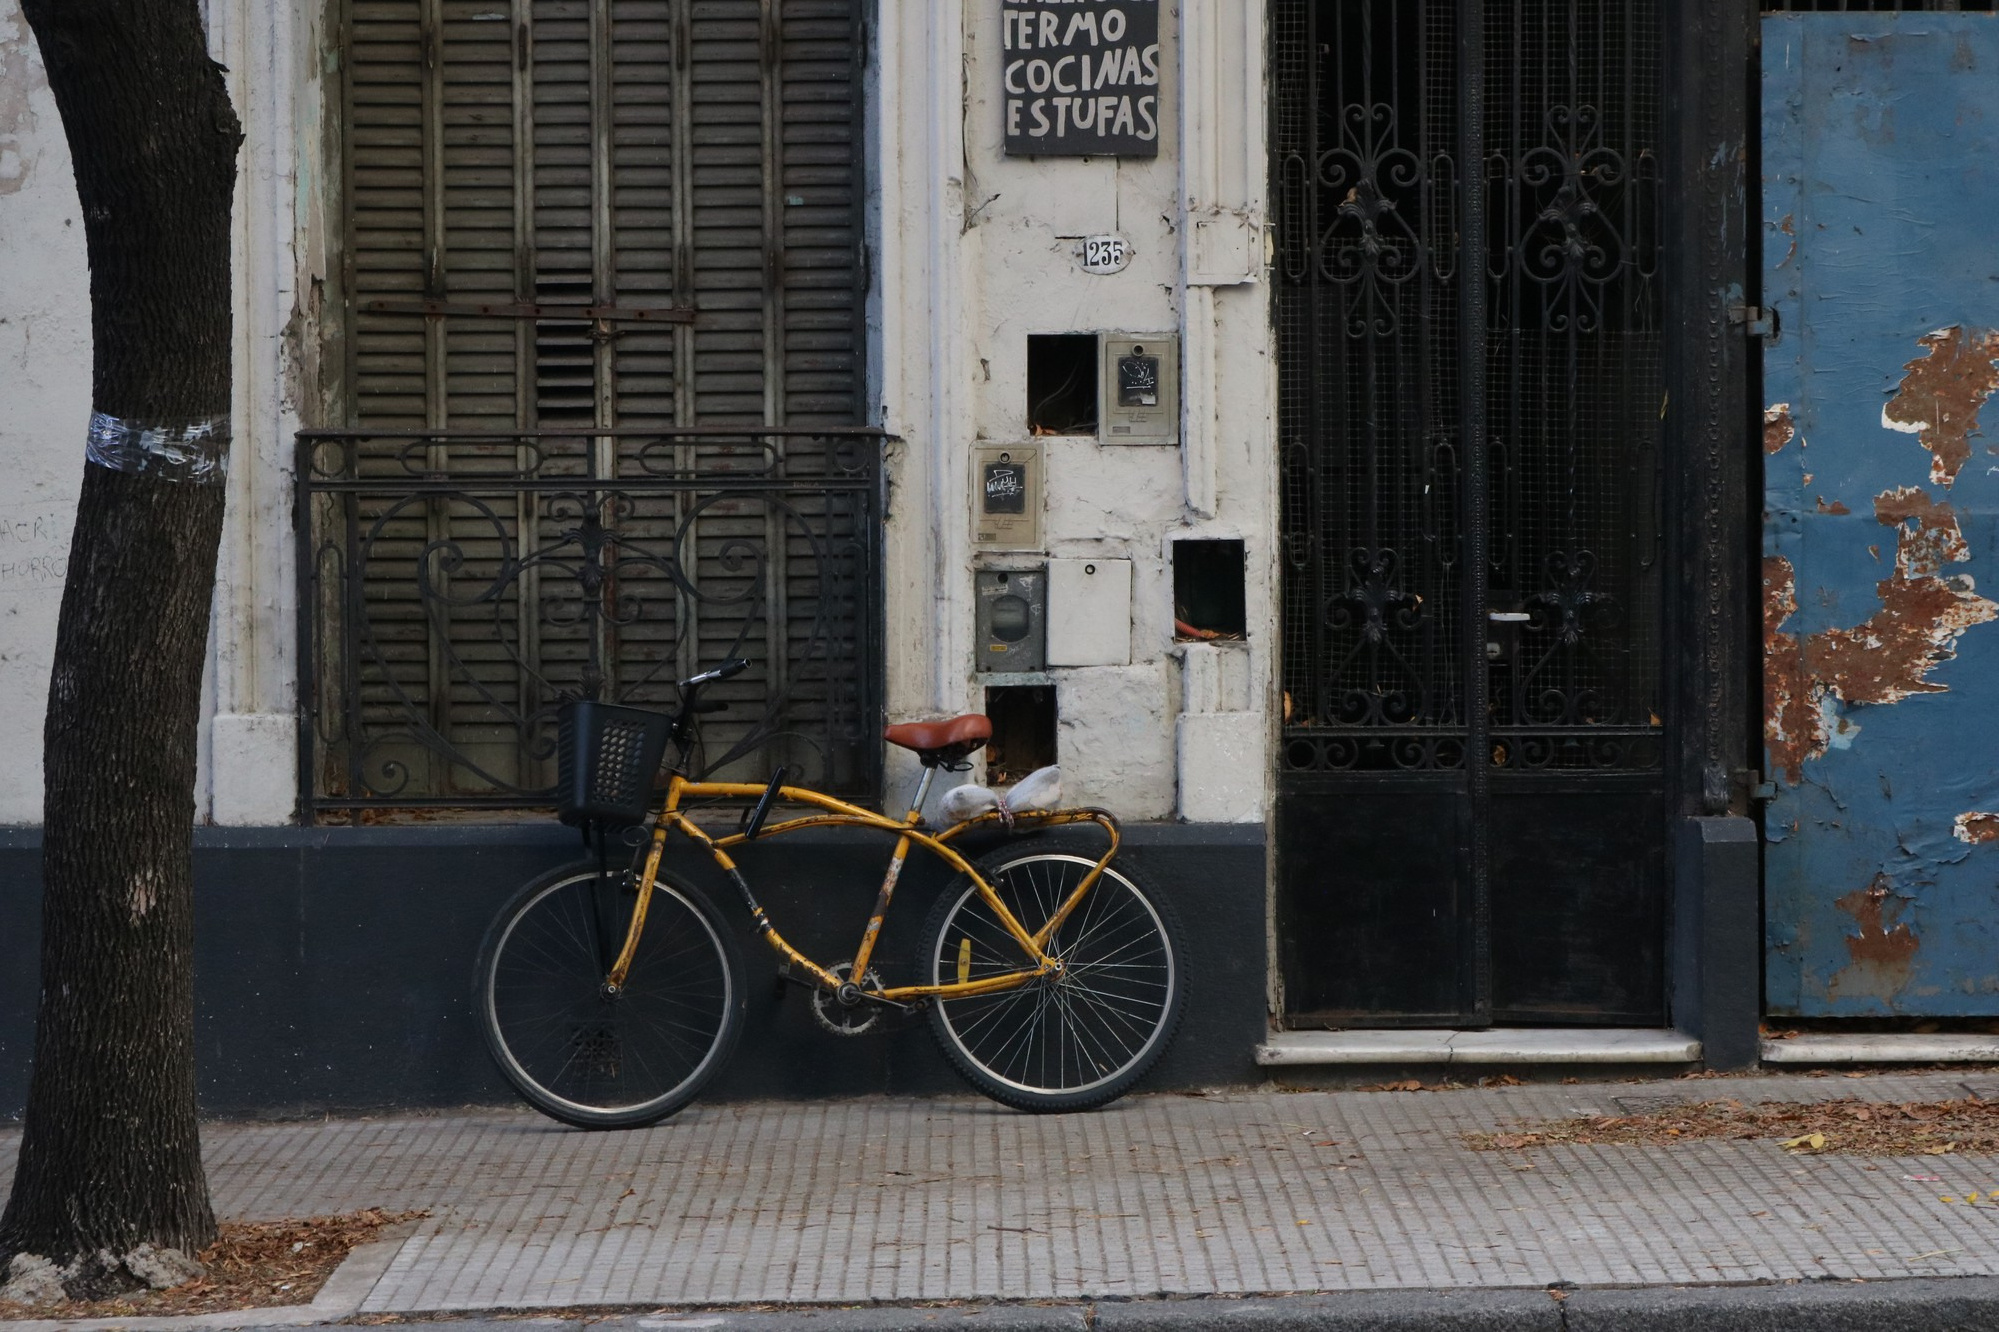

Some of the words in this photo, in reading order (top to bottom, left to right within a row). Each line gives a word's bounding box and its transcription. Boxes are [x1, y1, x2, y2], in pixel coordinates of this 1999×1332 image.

[1003, 9, 1126, 49] TERMO
[1005, 44, 1158, 94] COCINAS
[1007, 95, 1157, 140] ESTUFAS
[1083, 241, 1123, 266] 1235
